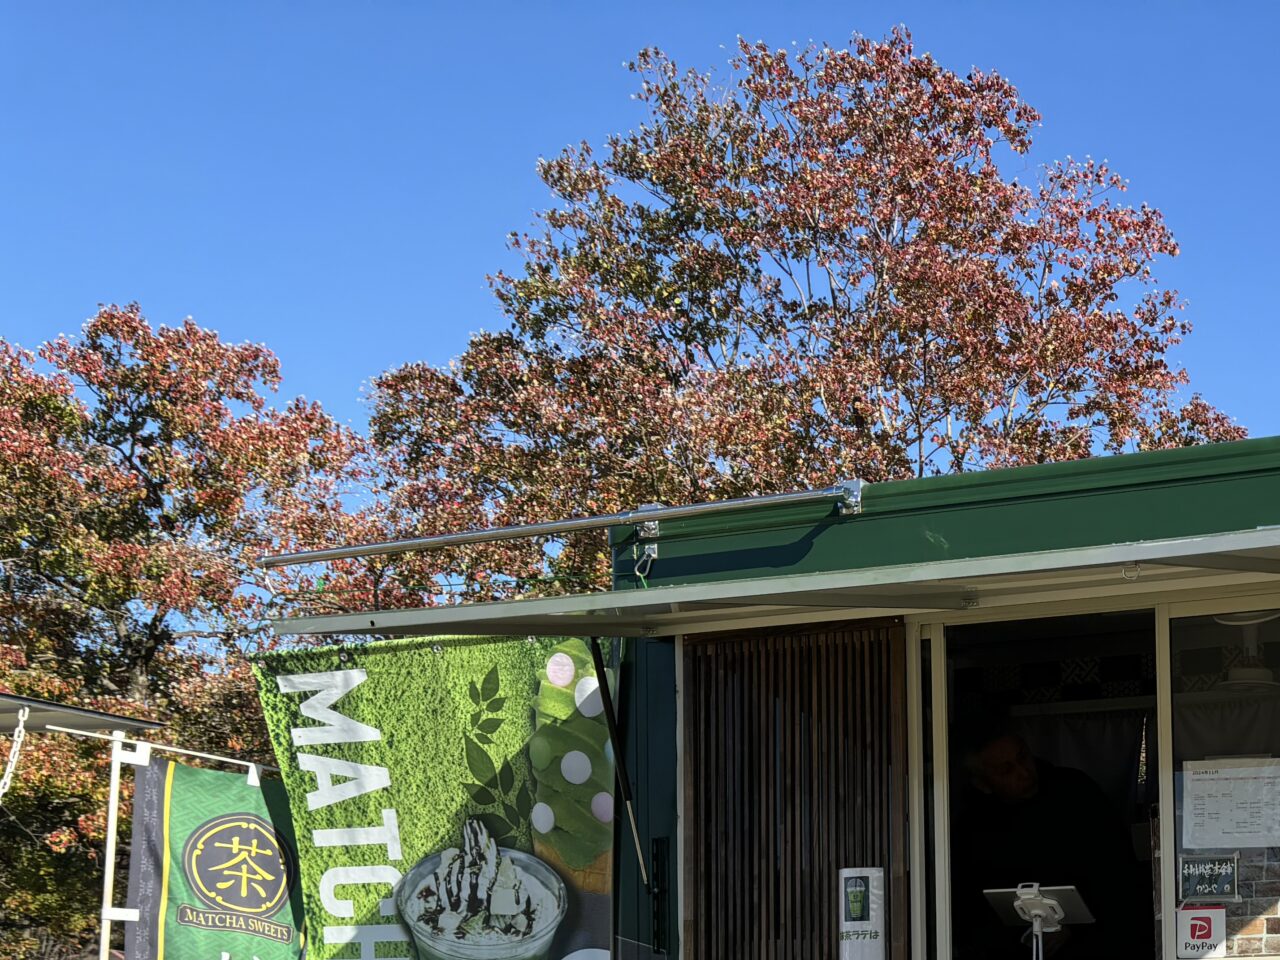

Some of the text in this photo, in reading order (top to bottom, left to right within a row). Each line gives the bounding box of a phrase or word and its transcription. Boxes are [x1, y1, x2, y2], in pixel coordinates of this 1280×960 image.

[208, 836, 275, 898] 茶
[184, 908, 288, 940] MATCHA SWEETS
[1184, 941, 1219, 952] PayPay
